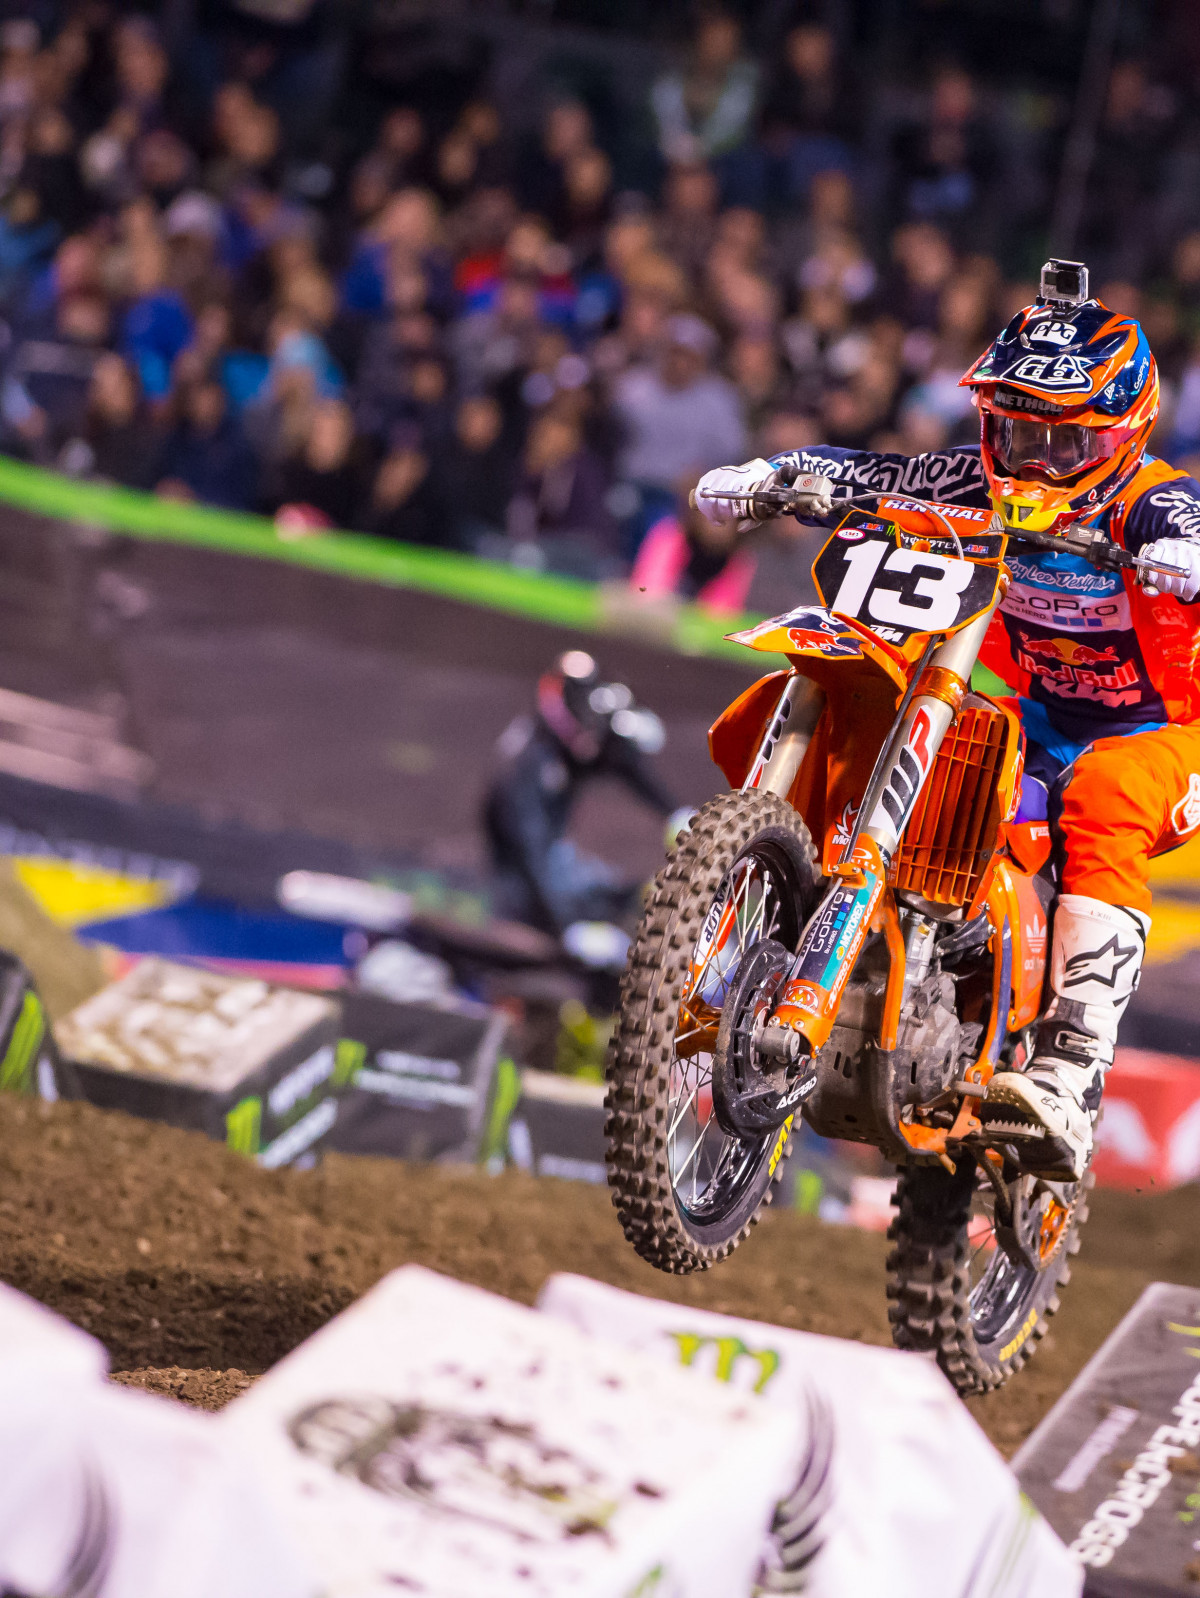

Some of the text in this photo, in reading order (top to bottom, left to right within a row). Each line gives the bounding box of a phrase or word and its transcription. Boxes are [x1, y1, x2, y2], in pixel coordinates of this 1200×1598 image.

[1033, 321, 1073, 340] PPG
[993, 391, 1064, 414] METHOD
[883, 498, 988, 523] RENTHAL
[901, 532, 960, 549] MOSTER
[831, 539, 975, 632] 13
[1004, 556, 1028, 580] roy
[1055, 571, 1116, 592] Designs
[868, 623, 905, 643] KTM
[1018, 649, 1140, 690] Red Bull
[810, 891, 845, 953] GoPro
[839, 901, 866, 949] MOTOREX
